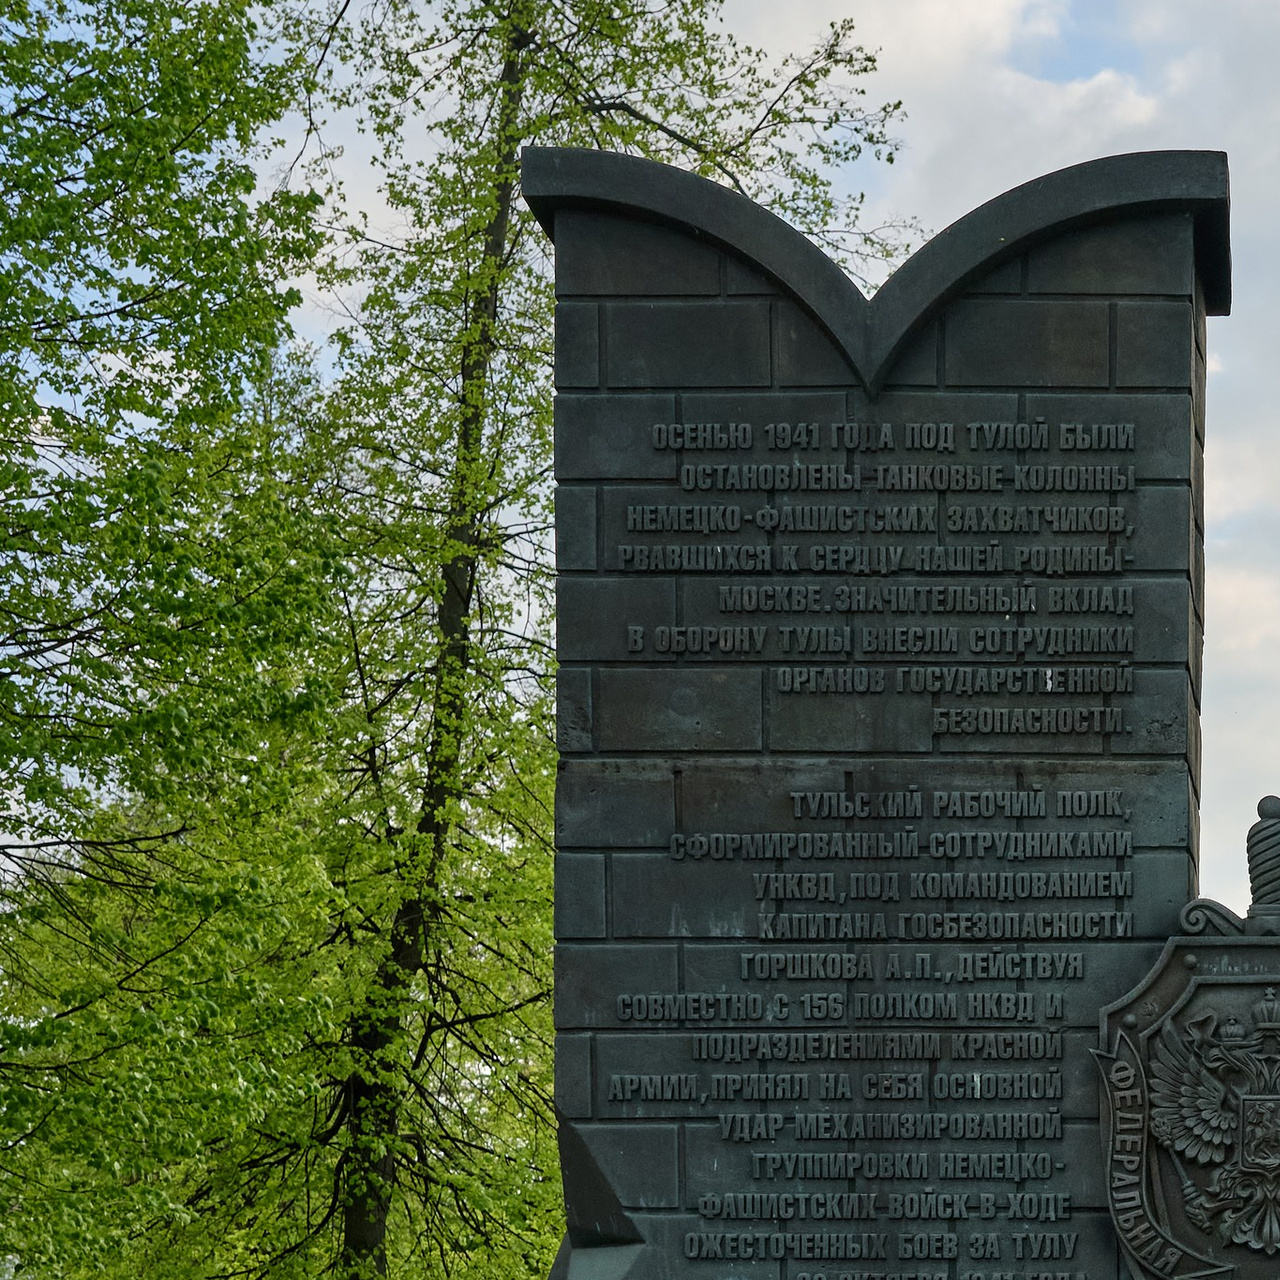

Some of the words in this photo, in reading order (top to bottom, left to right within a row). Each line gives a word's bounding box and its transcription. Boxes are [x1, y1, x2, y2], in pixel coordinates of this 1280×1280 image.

[652, 423, 752, 450] ОСЕНЬЮ
[765, 423, 820, 450] 1941
[831, 423, 894, 450] ГОДА
[905, 423, 955, 453] ПОД
[968, 417, 1048, 449] ТУЛОЙ
[1060, 423, 1134, 450] БЫЛИ
[681, 465, 860, 491] ОСТАНОВЛЕНЫ
[875, 465, 1002, 491] ТАНКОВЫЕ
[1014, 465, 1134, 491] КОЛОННЫ
[627, 506, 936, 534] НЕМЕЦКО-ФАШИСТСКИХ
[948, 506, 1134, 537] ЗАХВАТЧИКОВ,
[618, 546, 772, 572] РВАВШИХСЯ
[782, 546, 797, 572] К
[810, 546, 903, 575] СЕРДЦУ
[915, 541, 1003, 571] НАШЕЙ
[1048, 586, 1134, 615] ВКЛАД
[628, 627, 644, 653] В
[655, 627, 766, 653] ОБОРОНУ
[779, 627, 850, 653] ТУЛЫ
[862, 627, 958, 653] ВНЕСЛИ
[969, 626, 1134, 656] СОТРУДНИКИ
[777, 667, 885, 693] ОРГАНОВ
[896, 661, 1133, 695] ГОСУДАРСТВЕННОЙ
[933, 708, 1132, 734] БЕЗОПАСНОСТИ.
[790, 785, 922, 818] ТУЛЬСКИЙ
[933, 785, 1046, 818] РАБОЧИЙ
[1057, 790, 1132, 821] ПОЛК,
[670, 826, 918, 859] СФОРМИРОВАННЫЙ
[929, 831, 1132, 860] СОТРУДНИКАМИ
[911, 871, 1132, 900] КОМАНДОВАНИЕМ
[758, 912, 886, 939] КАПИТАНА
[899, 912, 1132, 939] ГОСБЕЗОПАСНОСТИ
[740, 953, 873, 980] ГОРШКОВА
[617, 993, 762, 1020] СОВМЕСТНО
[774, 993, 788, 1020] С
[800, 993, 843, 1020] 156
[855, 993, 956, 1020] ПОЛКОМ
[968, 993, 1034, 1022] НКВД
[1046, 993, 1062, 1020] И
[692, 1034, 940, 1061] ПОДРАЗДЕЛЕНИЯМИ
[952, 1028, 1061, 1059] КРАСНОЙ
[819, 1073, 851, 1099] НА
[862, 1073, 923, 1099] СЕБЯ
[935, 1067, 1062, 1099] ОСНОВНОЙ
[718, 1114, 784, 1142] УДАР
[794, 1107, 1062, 1140] МЕХАНИЗИРОВАННОЙ
[752, 1153, 928, 1179] ГРУППИРОВКИ
[1109, 1060, 1183, 1276] ФЕДЕРАЛЬНАЯ
[698, 1193, 876, 1219] ФАШИСТСКИХ
[888, 1187, 968, 1219] ВОЙСК
[980, 1193, 995, 1219] В
[1006, 1193, 1071, 1221] ХОДЕ
[684, 1233, 886, 1260] ОЖЕСТОЧЕННЫХ
[898, 1233, 957, 1260] БОЕВ
[969, 1233, 999, 1260] ЗА
[1010, 1233, 1076, 1260] ТУЛУ
